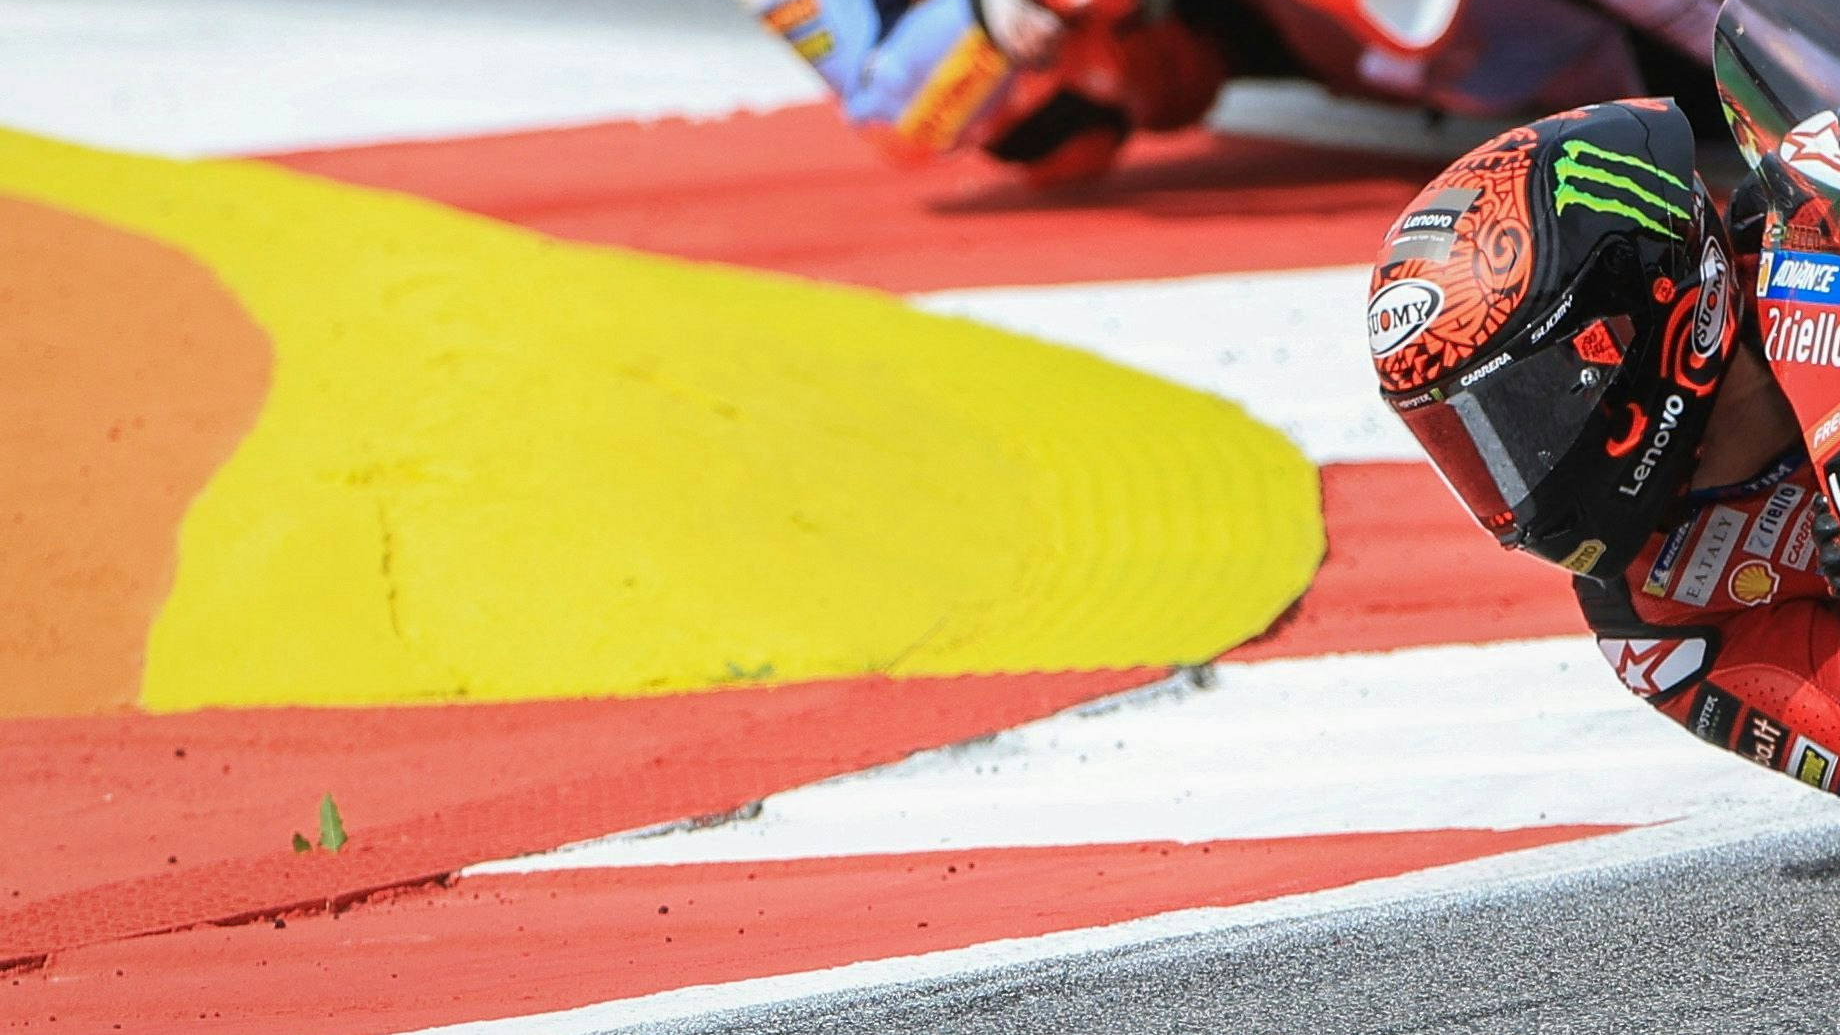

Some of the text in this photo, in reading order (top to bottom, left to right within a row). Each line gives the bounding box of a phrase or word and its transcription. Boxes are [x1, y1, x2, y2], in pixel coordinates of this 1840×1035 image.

[1402, 213, 1453, 230] Lenovo
[1771, 259, 1840, 293] ADVANCE
[1459, 351, 1513, 387] CARRERA
[1619, 394, 1685, 497] Lenovo
[1758, 486, 1798, 535] riello
[1686, 515, 1733, 600] EATALY
[1787, 507, 1816, 565] CARRE
